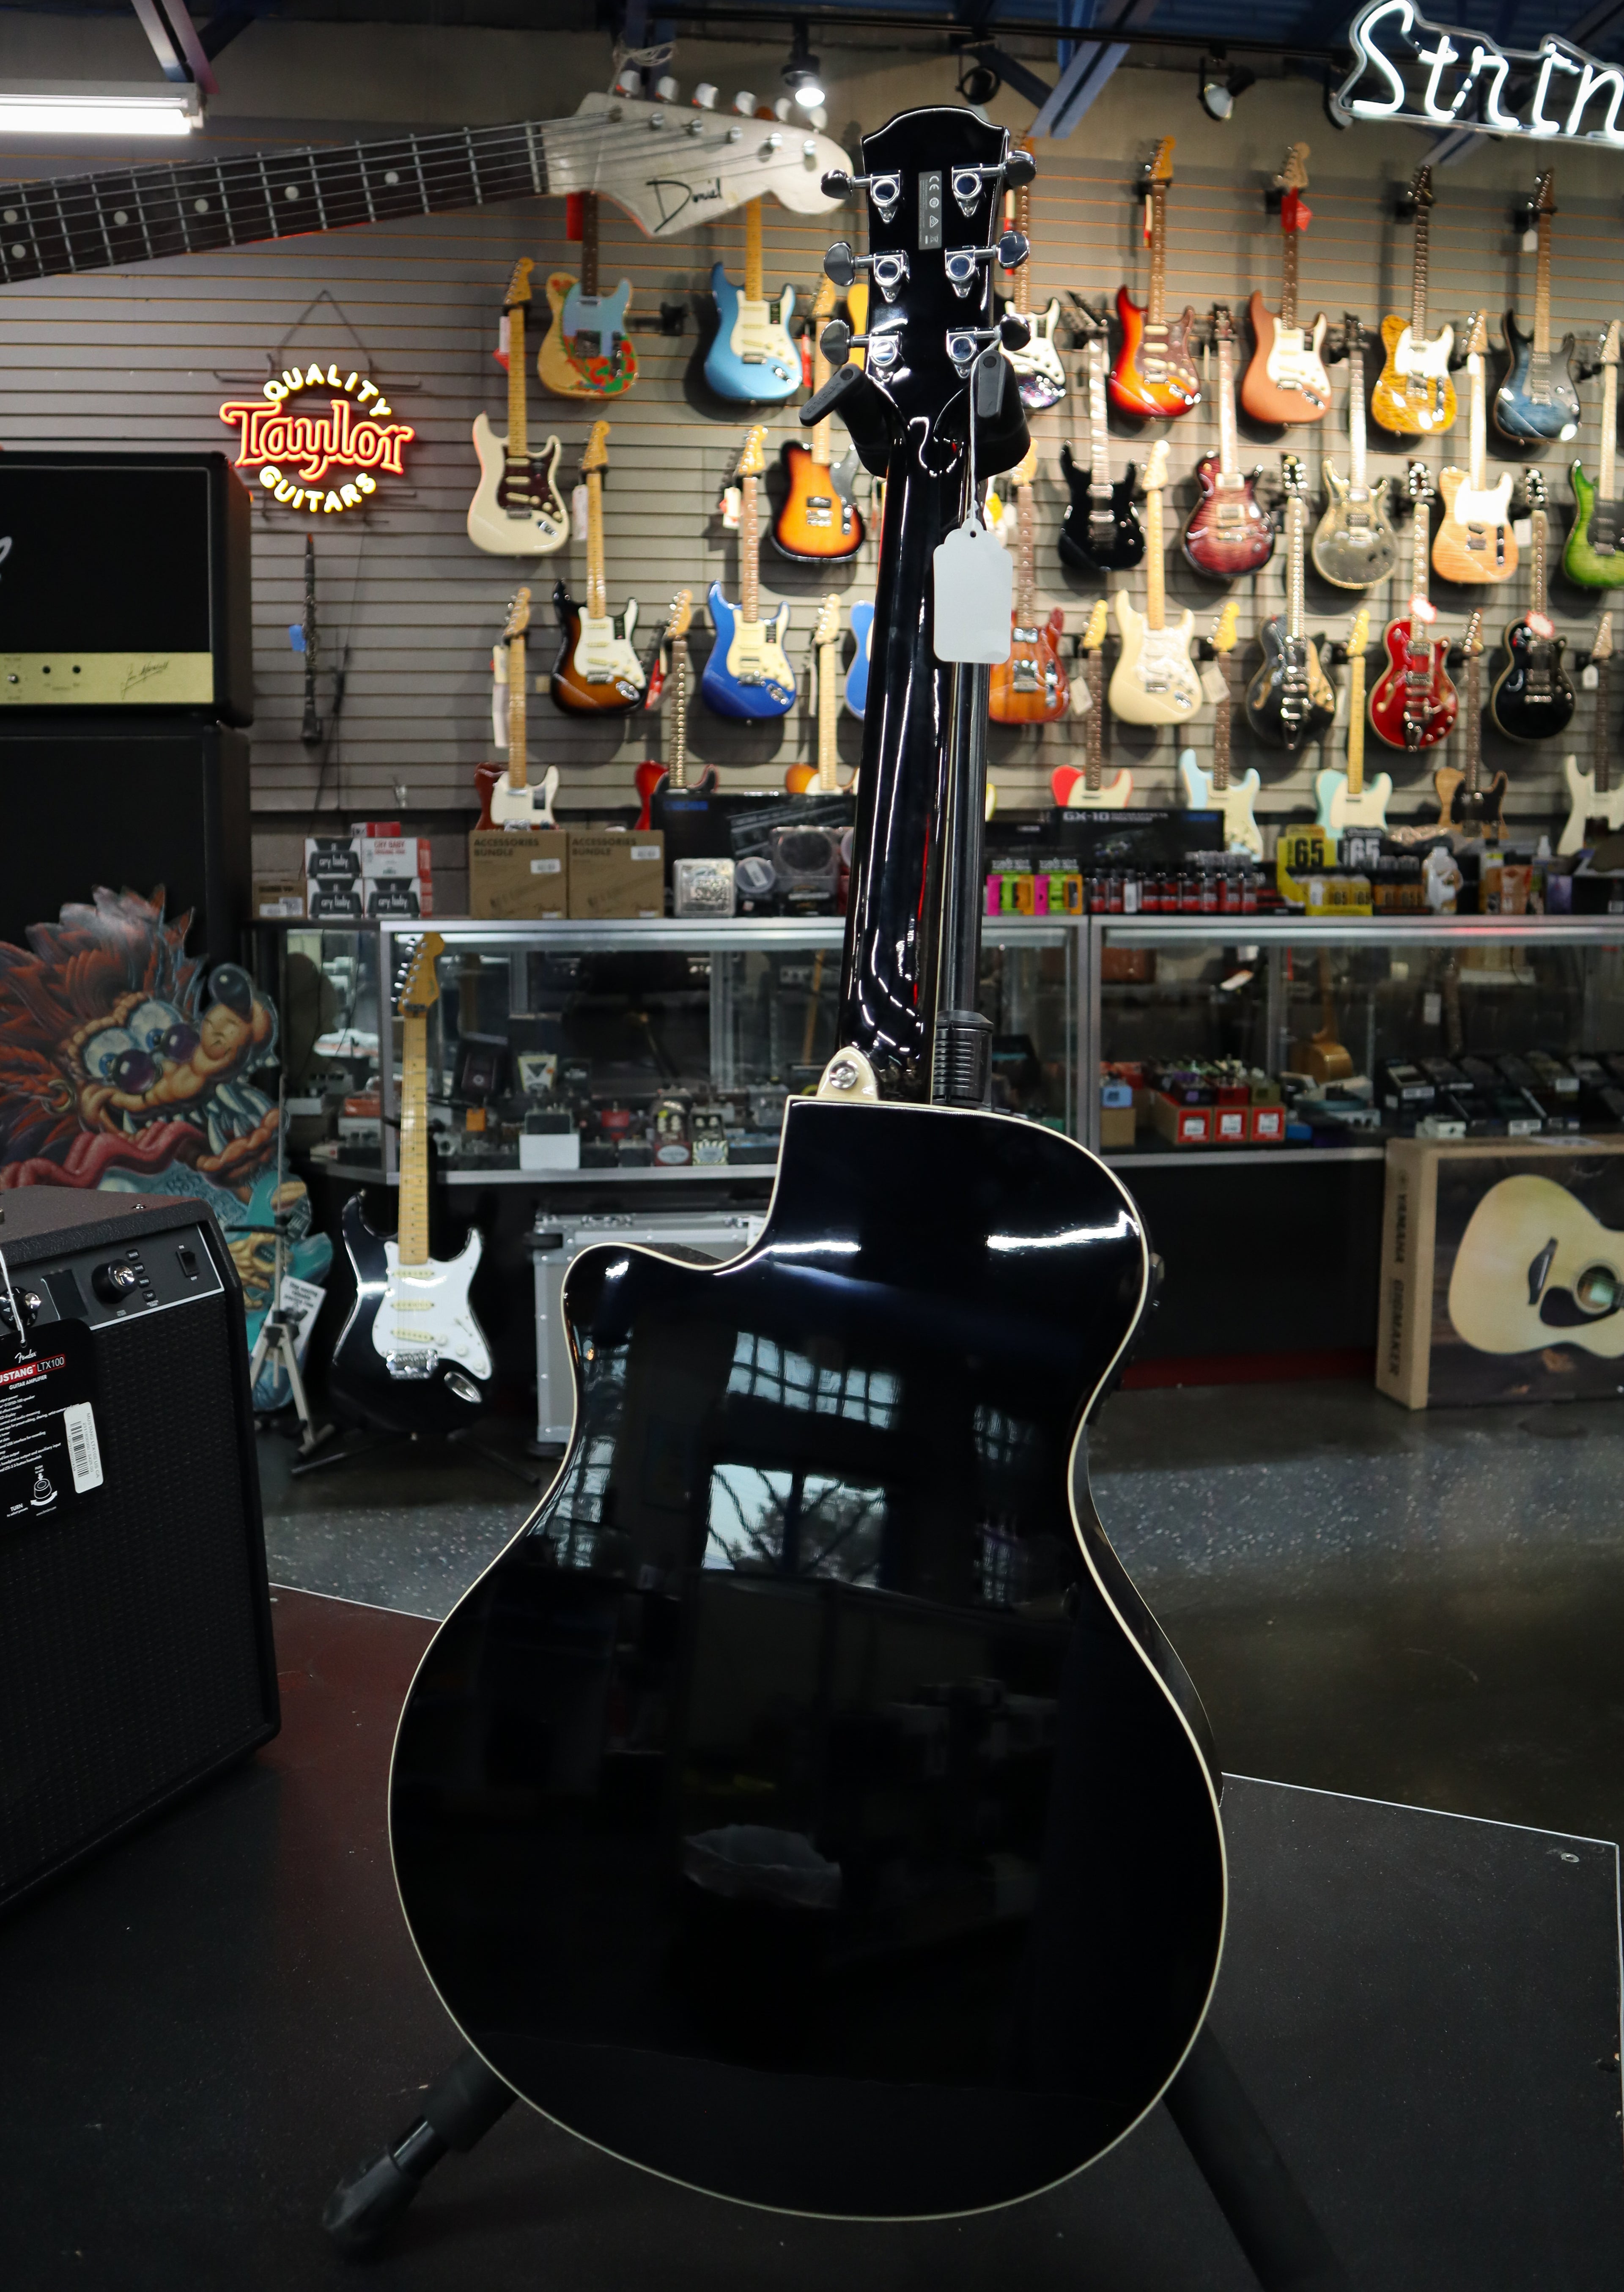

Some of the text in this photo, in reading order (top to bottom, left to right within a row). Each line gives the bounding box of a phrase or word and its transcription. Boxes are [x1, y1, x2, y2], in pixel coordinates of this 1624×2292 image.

[263, 363, 392, 417] QUALITY
[219, 398, 416, 482] Taylor
[258, 465, 376, 513] GUITARS
[1063, 812, 1109, 822] GX-10
[332, 854, 348, 870] baby
[334, 894, 350, 910] baby
[392, 894, 408, 910] baby
[14, 1349, 36, 1363] Fender
[37, 1357, 64, 1372] LTX100
[9, 1374, 47, 1390] GUITAR AMPLIFIER
[94, 1460, 99, 1469] US
[95, 1470, 100, 1478] CA
[10, 1503, 23, 1512] TURN
